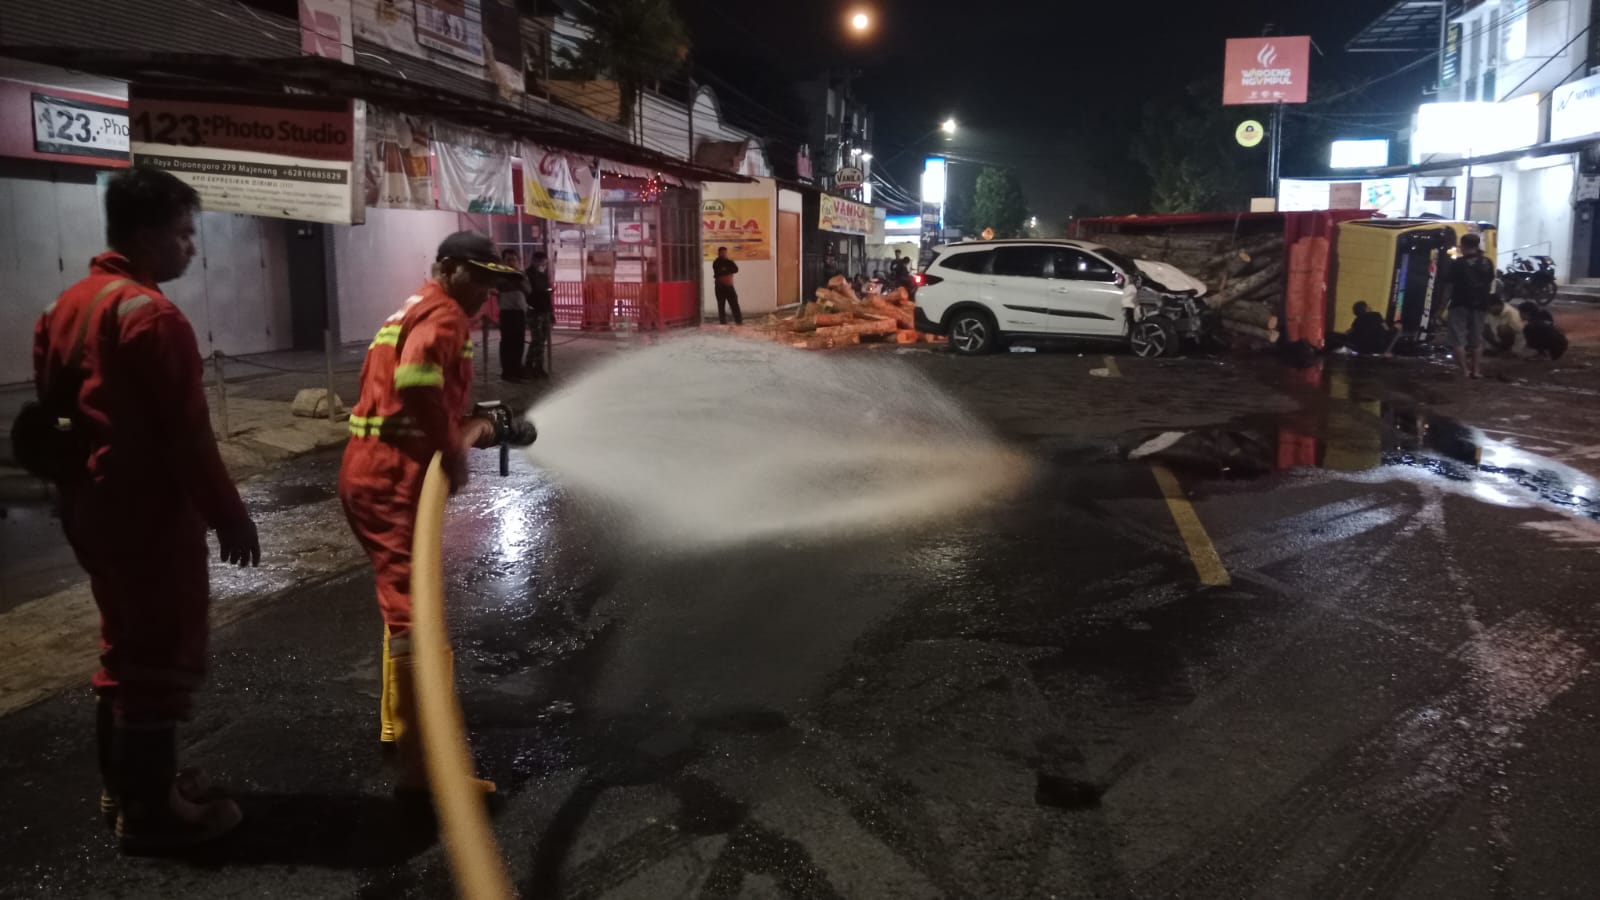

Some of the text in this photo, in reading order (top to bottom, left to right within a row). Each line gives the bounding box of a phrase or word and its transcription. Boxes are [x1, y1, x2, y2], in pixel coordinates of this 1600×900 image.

[277, 121, 346, 145] Studio
[173, 160, 220, 171] Diponegoro
[222, 163, 236, 172] 279
[239, 165, 278, 176] Majenang
